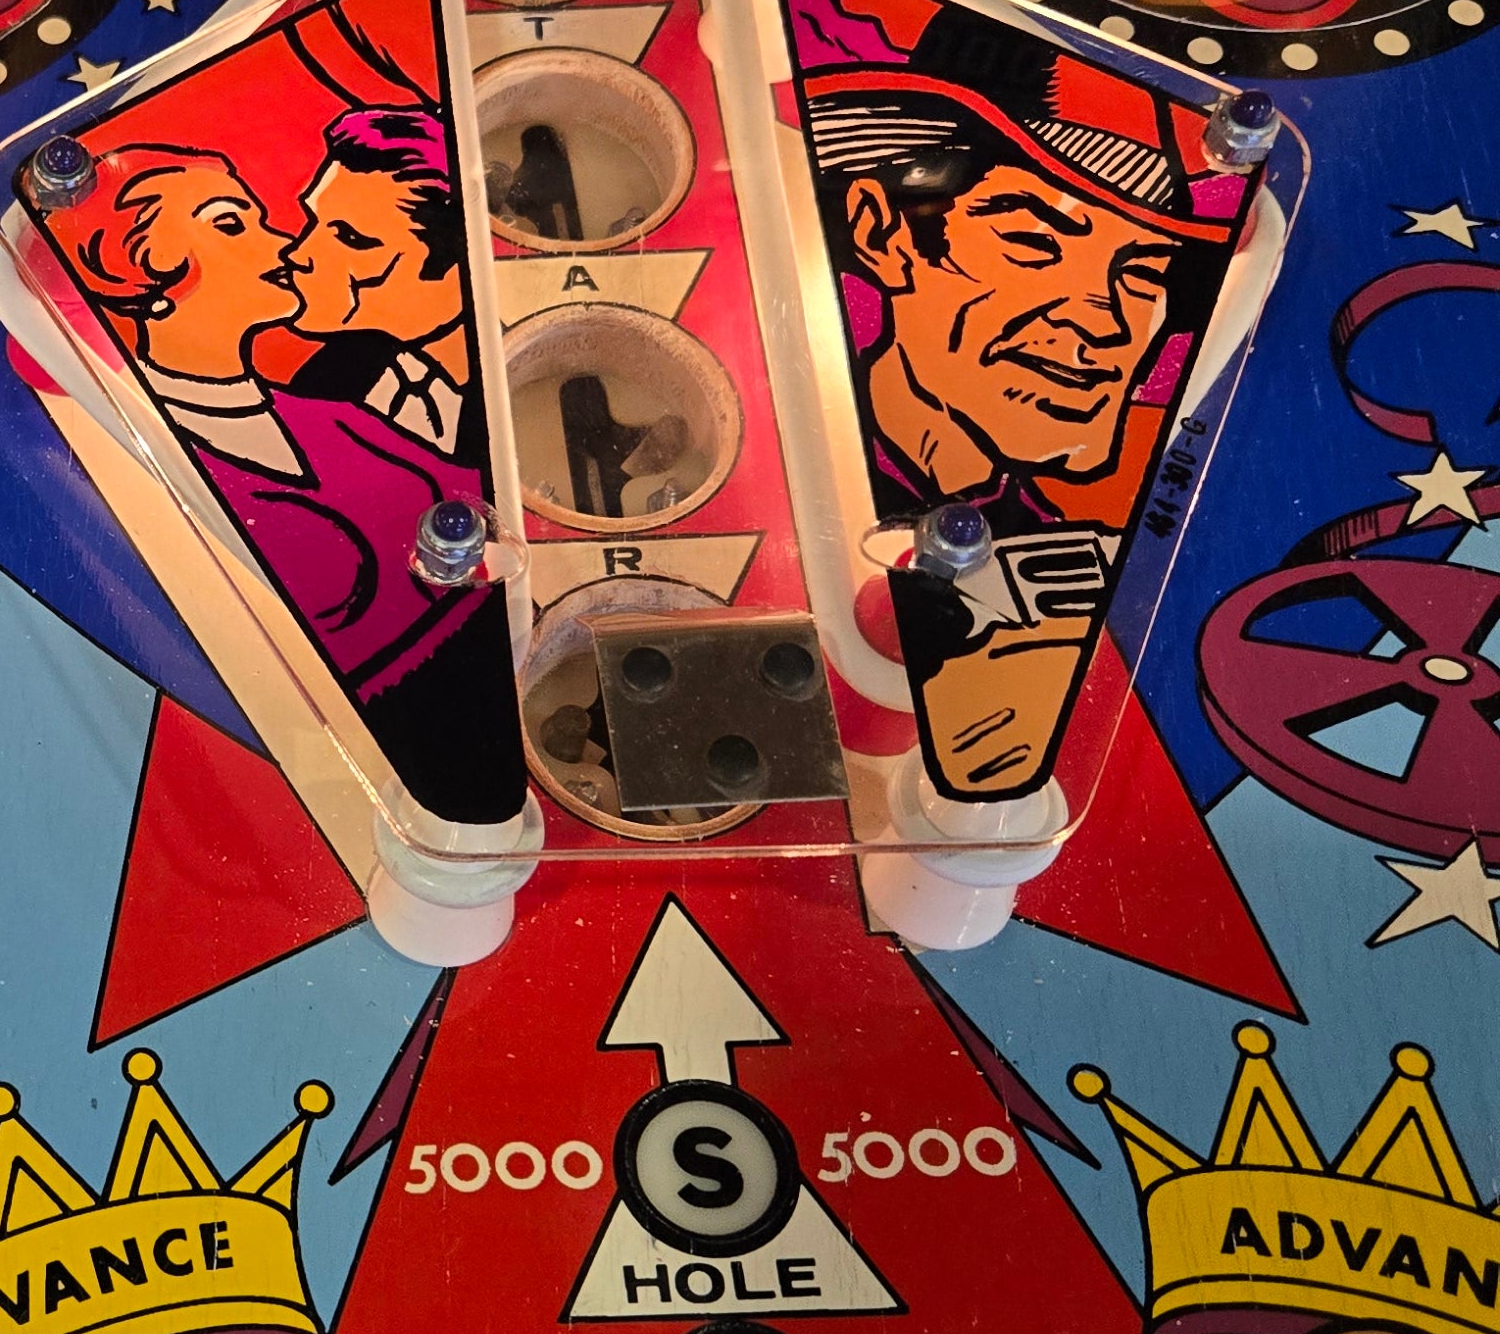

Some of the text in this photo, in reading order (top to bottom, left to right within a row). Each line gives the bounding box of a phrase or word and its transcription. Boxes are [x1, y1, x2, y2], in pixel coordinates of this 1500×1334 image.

[523, 16, 554, 41] T
[561, 264, 600, 292] A
[603, 547, 642, 575] R
[405, 1126, 1018, 1194] 5000 5000
[673, 1126, 745, 1209] S
[622, 1258, 822, 1305] HOLE
[1220, 1207, 1500, 1309] ADVAN
